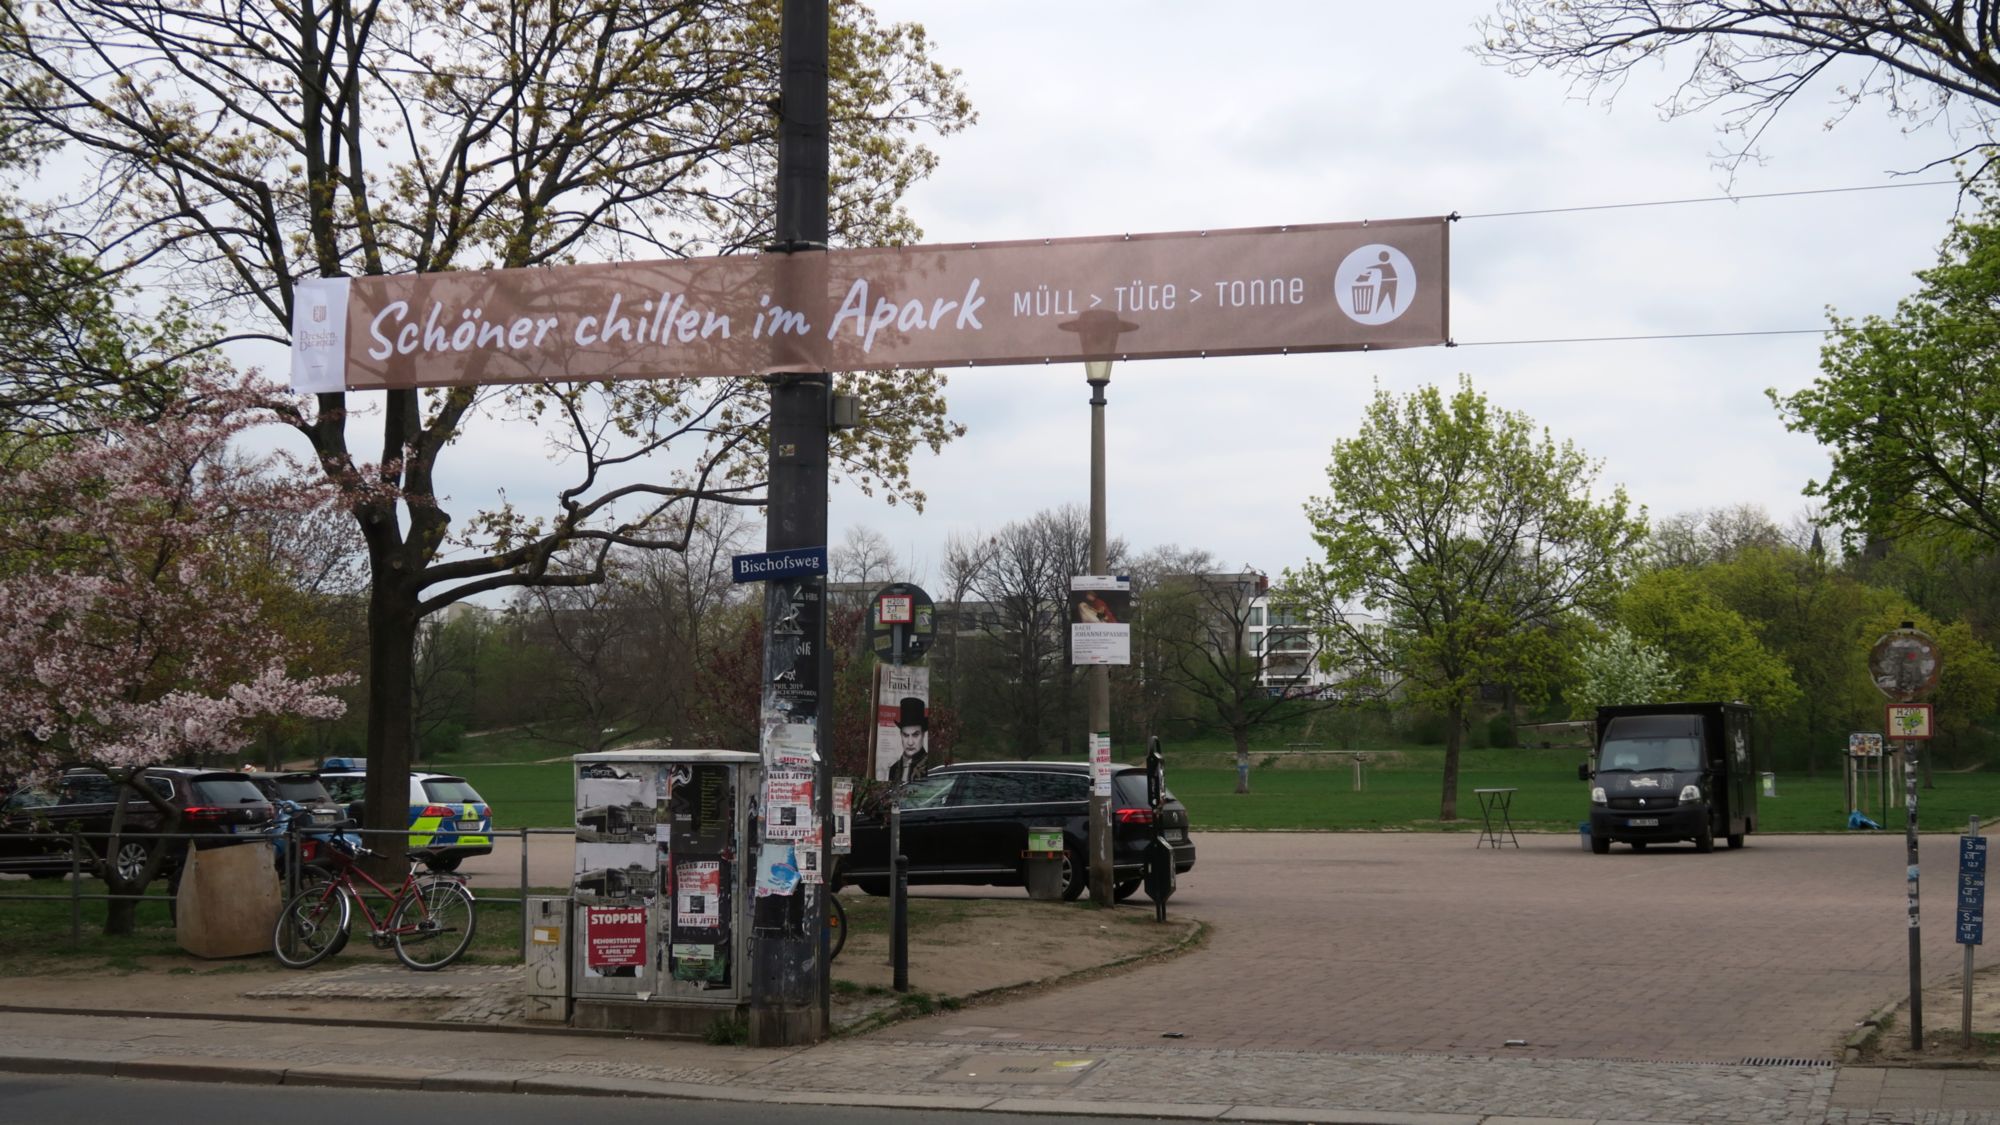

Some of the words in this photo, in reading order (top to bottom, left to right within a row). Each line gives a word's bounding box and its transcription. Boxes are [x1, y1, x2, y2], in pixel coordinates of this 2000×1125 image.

[1013, 285, 1078, 316] MÜLL
[368, 301, 558, 360] Schöner
[574, 292, 730, 346] chillen
[752, 294, 811, 340] im
[827, 278, 985, 353] Apark
[740, 556, 820, 574] Bischofsweg
[888, 671, 911, 690] Faust
[1966, 840, 1974, 849] S
[591, 912, 642, 925] STOPPEN
[1963, 912, 1971, 922] S
